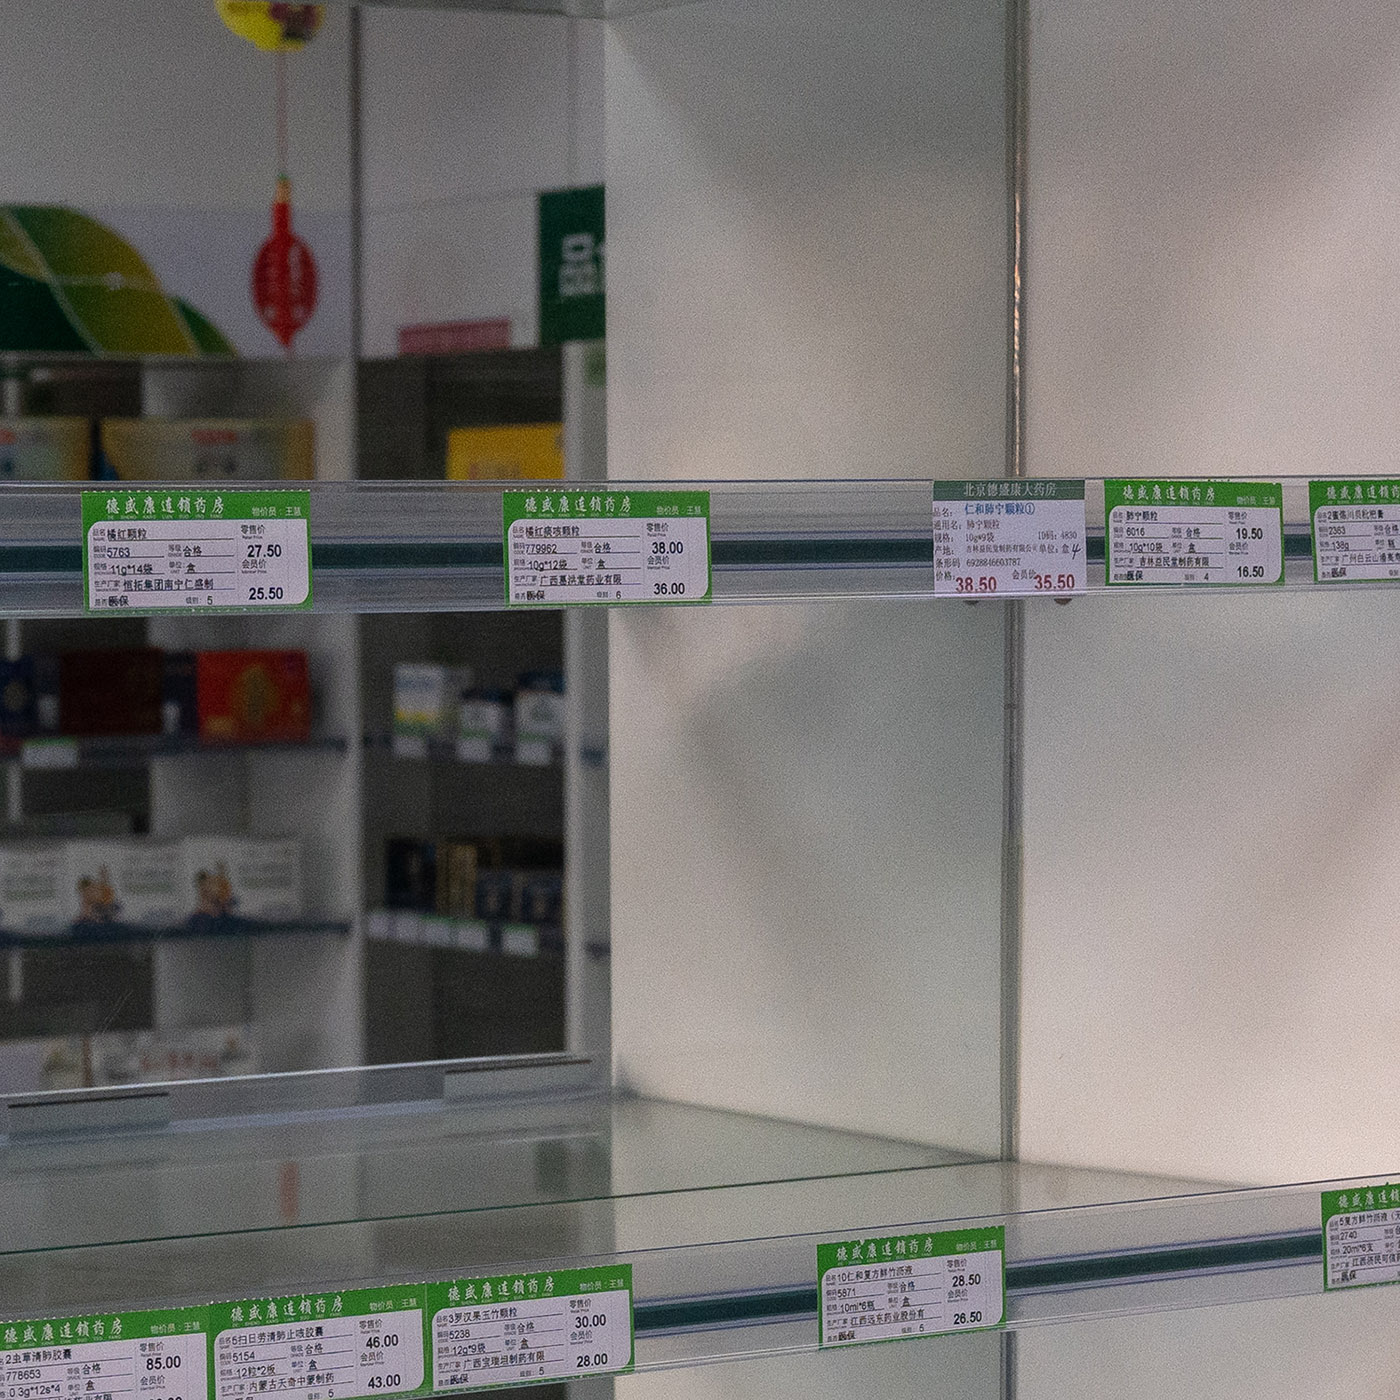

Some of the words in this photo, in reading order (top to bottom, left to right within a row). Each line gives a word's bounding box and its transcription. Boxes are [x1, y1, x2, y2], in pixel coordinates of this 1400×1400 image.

[964, 482, 1056, 496] 北京德盛康大药房
[1236, 528, 1263, 539] 19.50
[107, 547, 130, 558] 5763
[248, 545, 282, 557] 27.50
[526, 544, 557, 554] 779962
[652, 542, 683, 554] 38.00
[1237, 566, 1264, 578] 16.50
[654, 583, 685, 595] 36.00
[955, 576, 997, 592] 38.50
[1034, 574, 1075, 590] 35.50
[249, 587, 283, 600] 25.50
[952, 1274, 981, 1287] 28.50
[838, 1288, 856, 1297] 5871
[575, 1315, 606, 1328] 30.00
[954, 1311, 982, 1324] 26.50
[450, 1330, 470, 1339] 5238
[366, 1334, 398, 1349] 46.00
[5, 1349, 72, 1364] 2虫草清肺胶囊
[146, 1355, 181, 1370] 85.00
[233, 1352, 255, 1361] 5154
[577, 1353, 608, 1367] 28.00
[6, 1369, 41, 1381] 778653
[368, 1374, 401, 1388] 43.00
